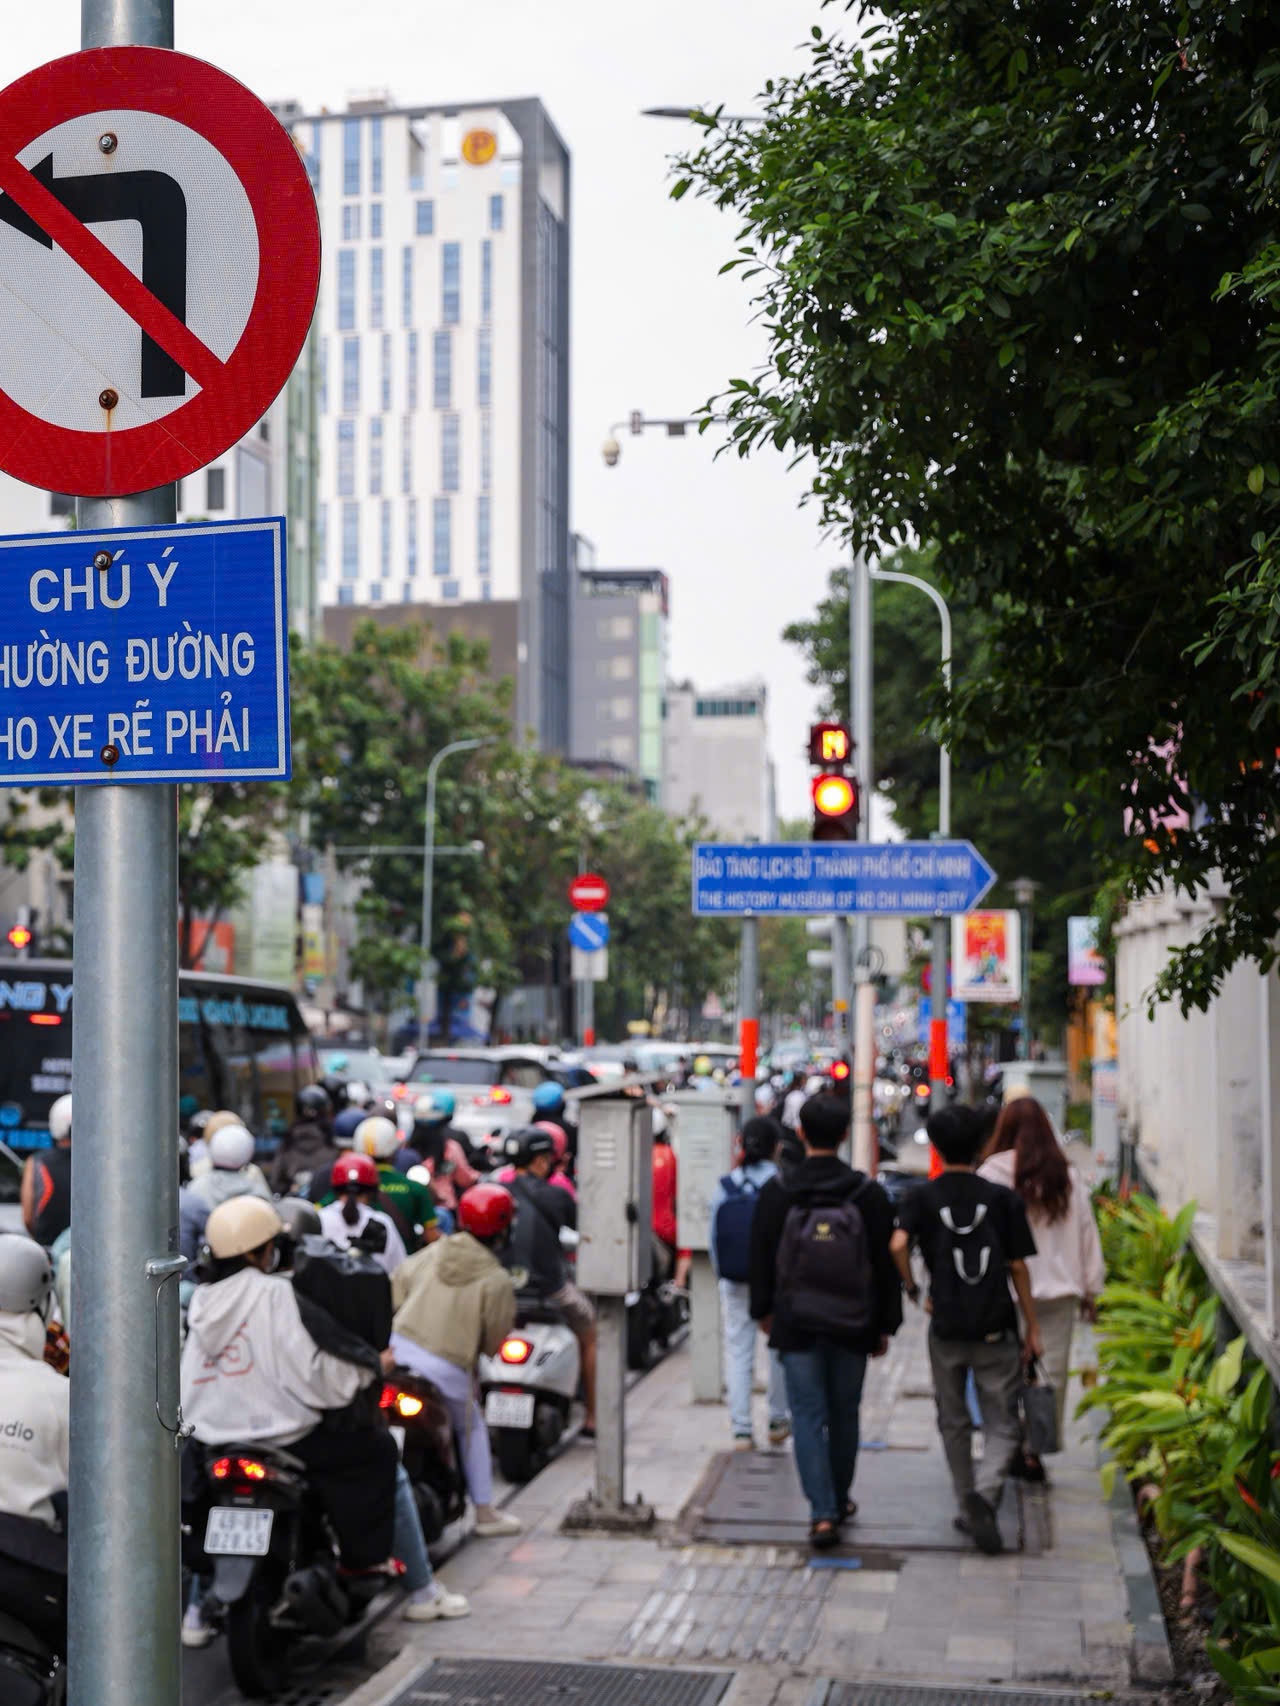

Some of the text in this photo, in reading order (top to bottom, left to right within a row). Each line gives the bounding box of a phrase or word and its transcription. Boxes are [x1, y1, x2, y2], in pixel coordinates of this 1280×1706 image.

[29, 546, 179, 613] CHÚ Ý
[125, 621, 256, 682] ĐƯỜNG
[48, 714, 94, 759] XE
[108, 699, 154, 756] RẼ
[166, 691, 250, 754] PHẢI
